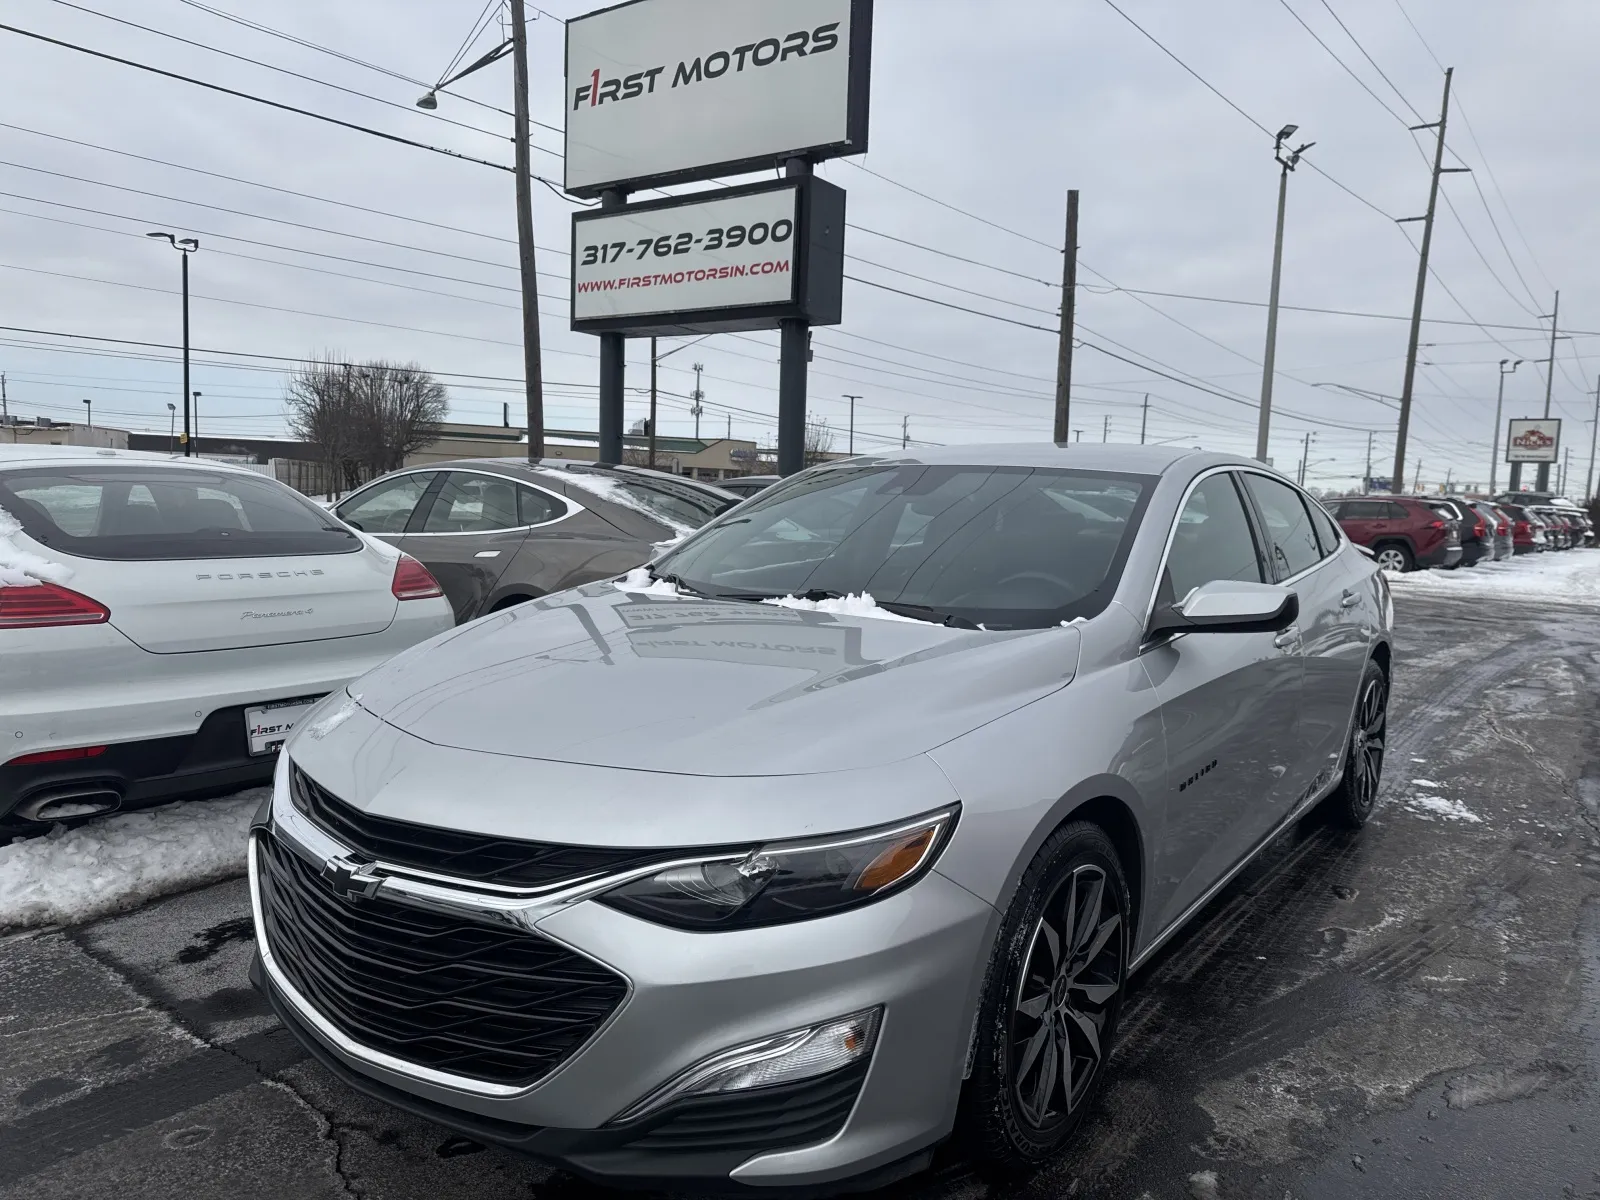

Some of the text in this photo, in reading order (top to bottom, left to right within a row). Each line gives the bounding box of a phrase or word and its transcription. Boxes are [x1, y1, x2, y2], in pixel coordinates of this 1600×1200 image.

[671, 21, 840, 88] MOTORS
[580, 218, 792, 266] 317-762-3900
[577, 260, 789, 293] WWW.FIRSTMOTORSIN.COM
[196, 569, 325, 580] PORSCHE
[240, 610, 304, 620] Panamera
